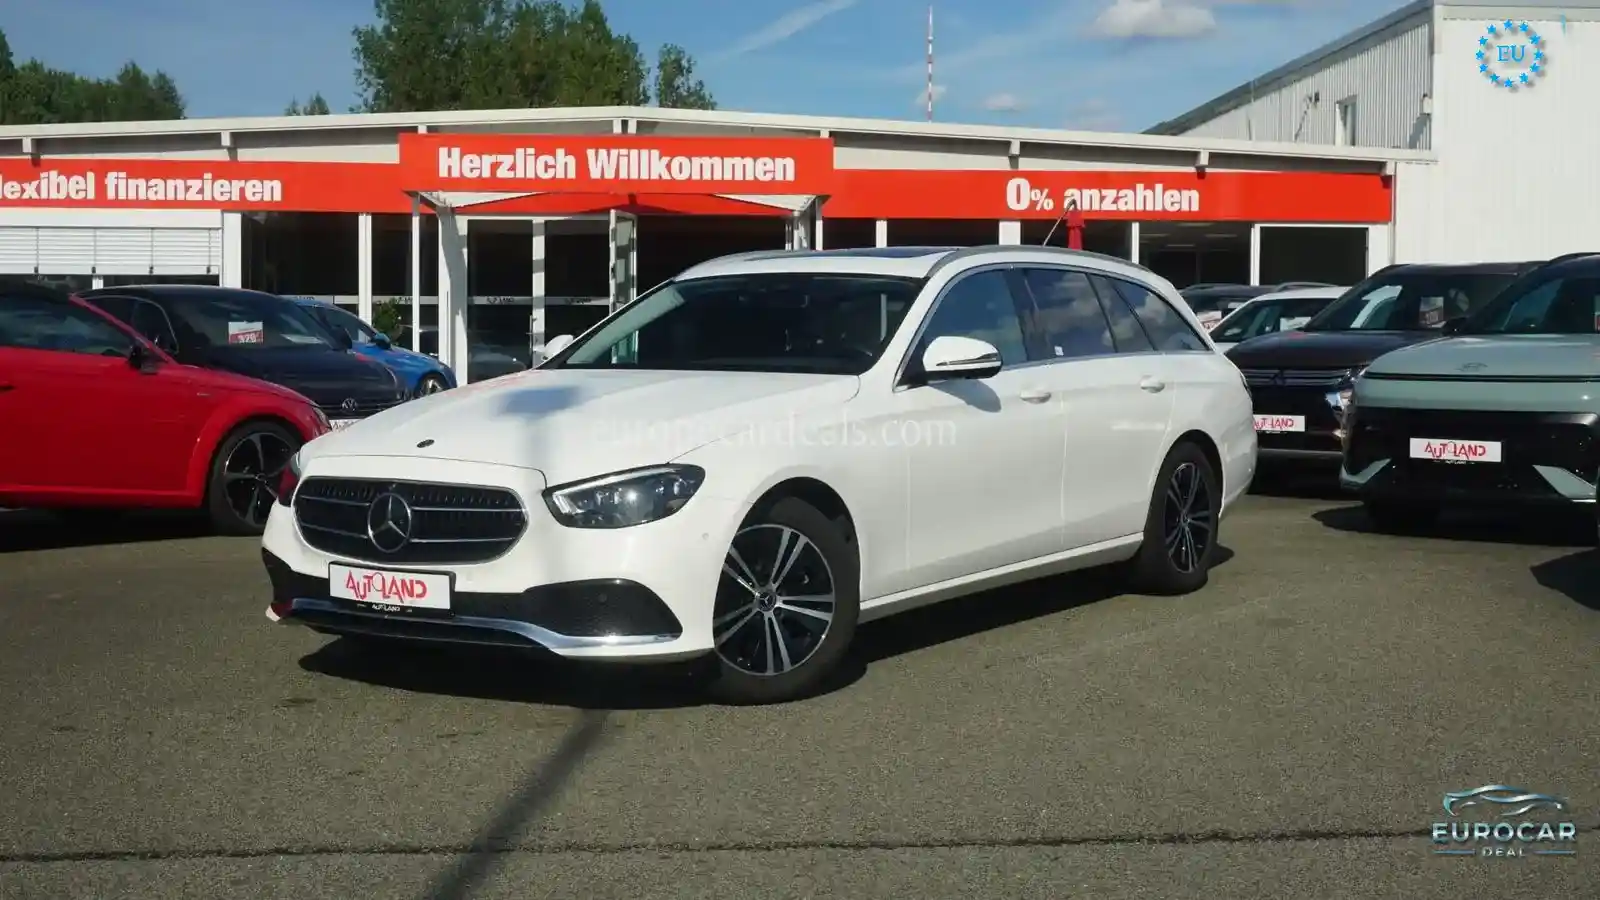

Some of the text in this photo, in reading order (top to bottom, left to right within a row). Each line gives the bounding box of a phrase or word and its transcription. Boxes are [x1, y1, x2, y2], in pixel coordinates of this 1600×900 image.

[438, 147, 795, 182] Herzlich Willkommen
[105, 171, 282, 202] finanzieren
[1005, 177, 1200, 211] 0% anzahlen
[1424, 441, 1487, 460] AUTOLAND
[345, 569, 428, 604] AUTOLAND
